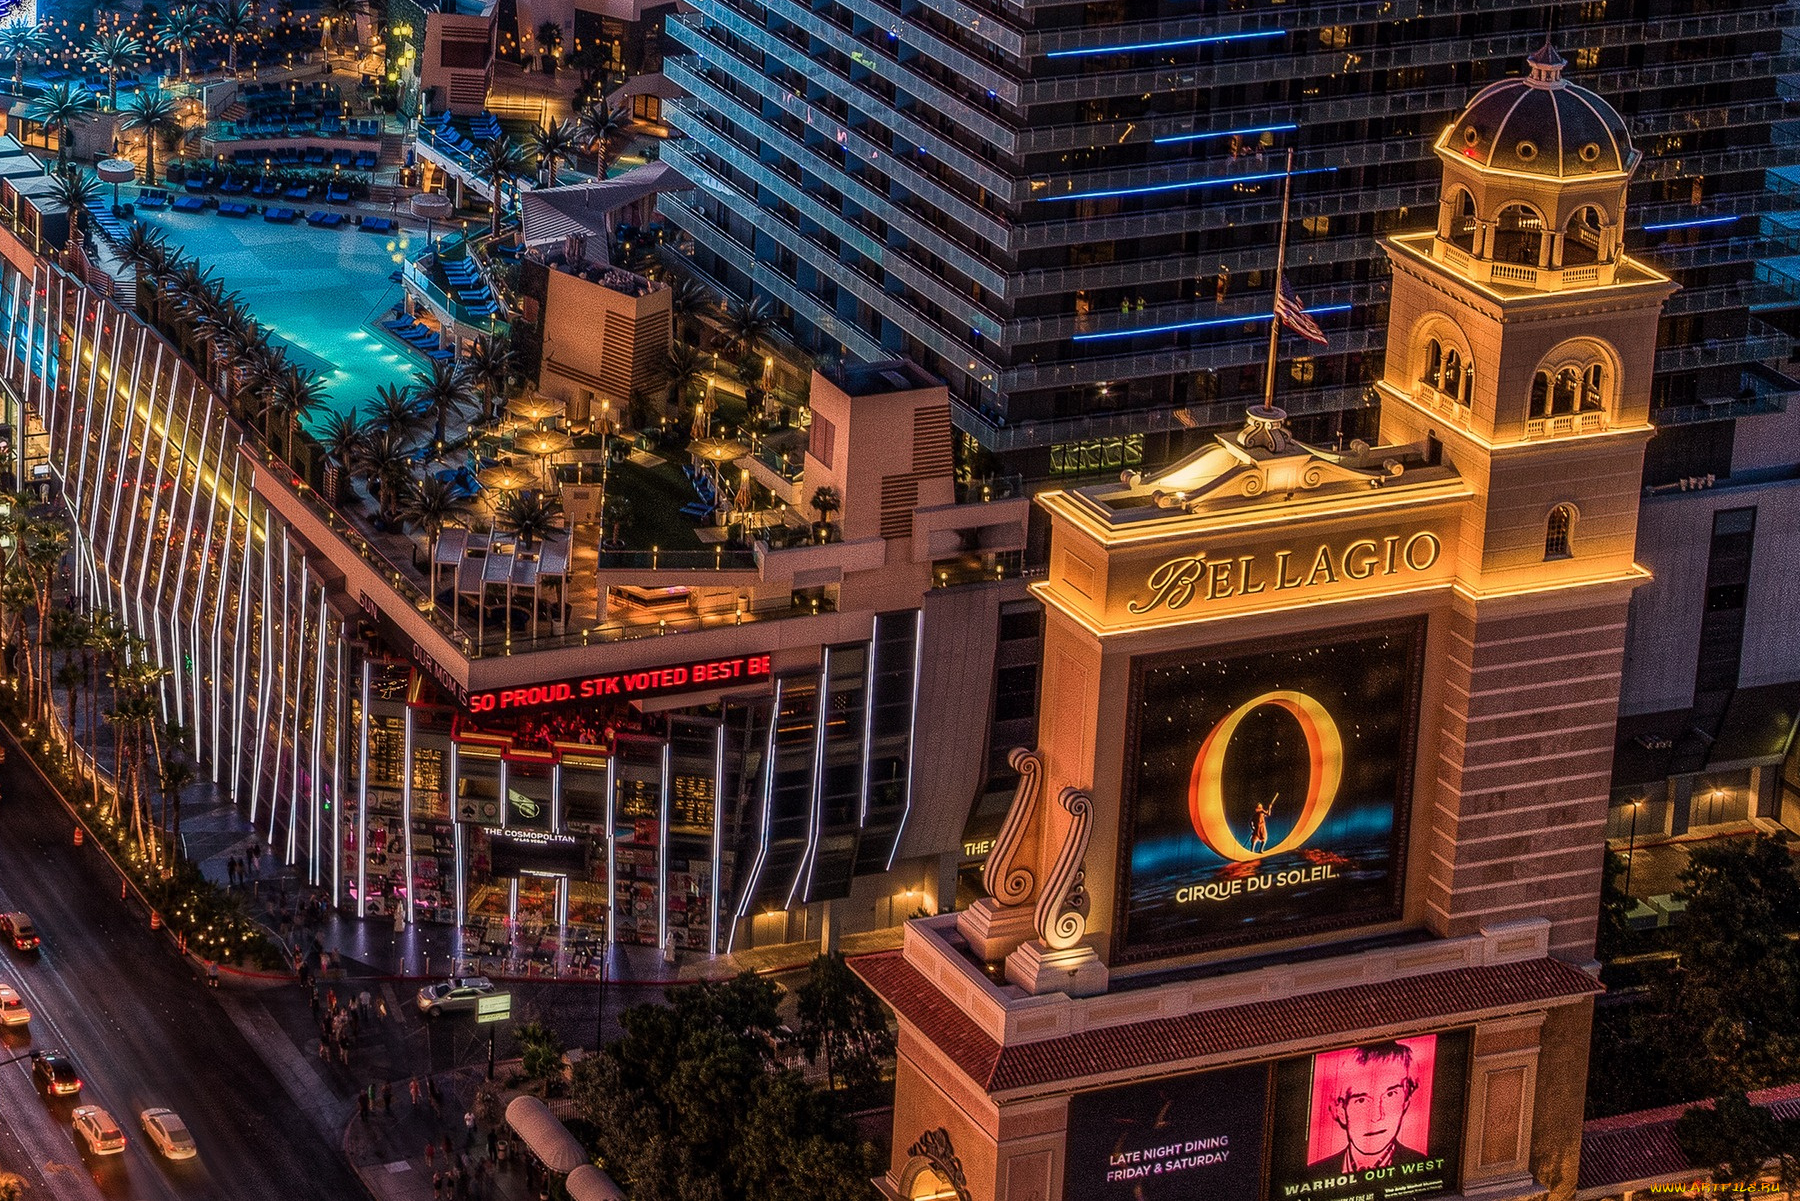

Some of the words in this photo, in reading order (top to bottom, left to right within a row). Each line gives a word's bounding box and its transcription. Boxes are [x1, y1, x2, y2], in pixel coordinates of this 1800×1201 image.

[1129, 531, 1442, 616] BELLAGIO
[470, 693, 495, 713] SO
[501, 684, 575, 708] PROUD.
[581, 677, 619, 698] STK
[623, 666, 688, 692] VOTED
[692, 659, 741, 682] BEST
[484, 827, 503, 836] THE
[504, 829, 575, 843] COSMOPOLITAN
[964, 840, 990, 856] THE
[1175, 882, 1243, 904] CIRQUE
[1246, 876, 1272, 892] DU
[1106, 1164, 1152, 1182] FRIDAY
[1153, 1163, 1163, 1174] &
[1165, 1150, 1230, 1171] SATURDAY
[1109, 1151, 1141, 1166] LATE
[1143, 1143, 1182, 1160] NIGHT
[1184, 1135, 1229, 1152] DINING
[1284, 1174, 1357, 1196] WARHOL
[1364, 1167, 1395, 1181] OUT
[1401, 1158, 1445, 1174] WEST
